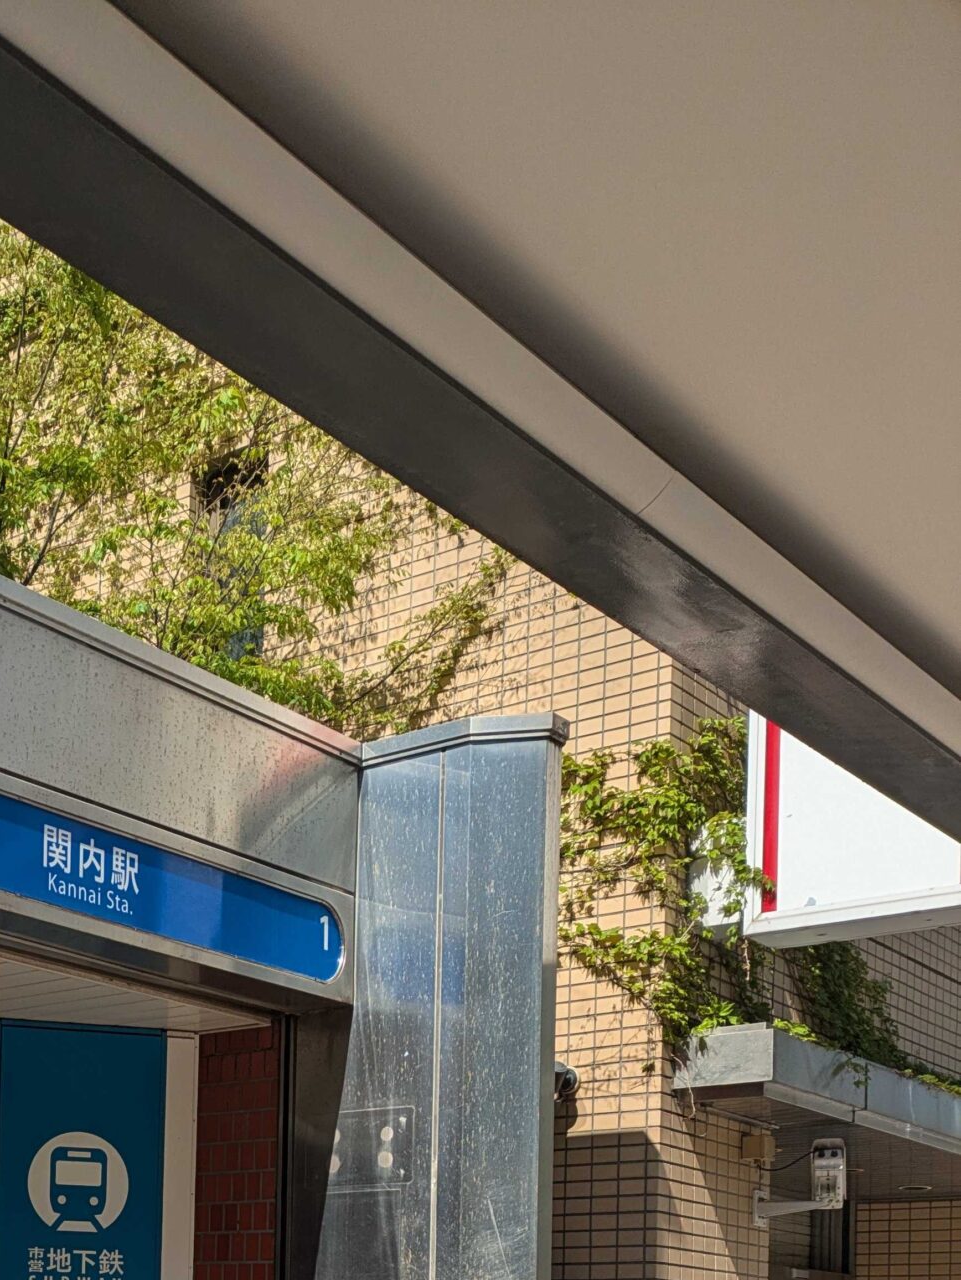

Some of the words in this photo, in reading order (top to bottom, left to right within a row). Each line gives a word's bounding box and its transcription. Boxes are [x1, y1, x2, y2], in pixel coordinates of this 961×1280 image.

[42, 824, 139, 895] 関内駅
[48, 872, 101, 906] Kannai
[106, 890, 134, 915] Sta.
[319, 915, 329, 951] 1
[46, 1247, 124, 1275] 地下鉄
